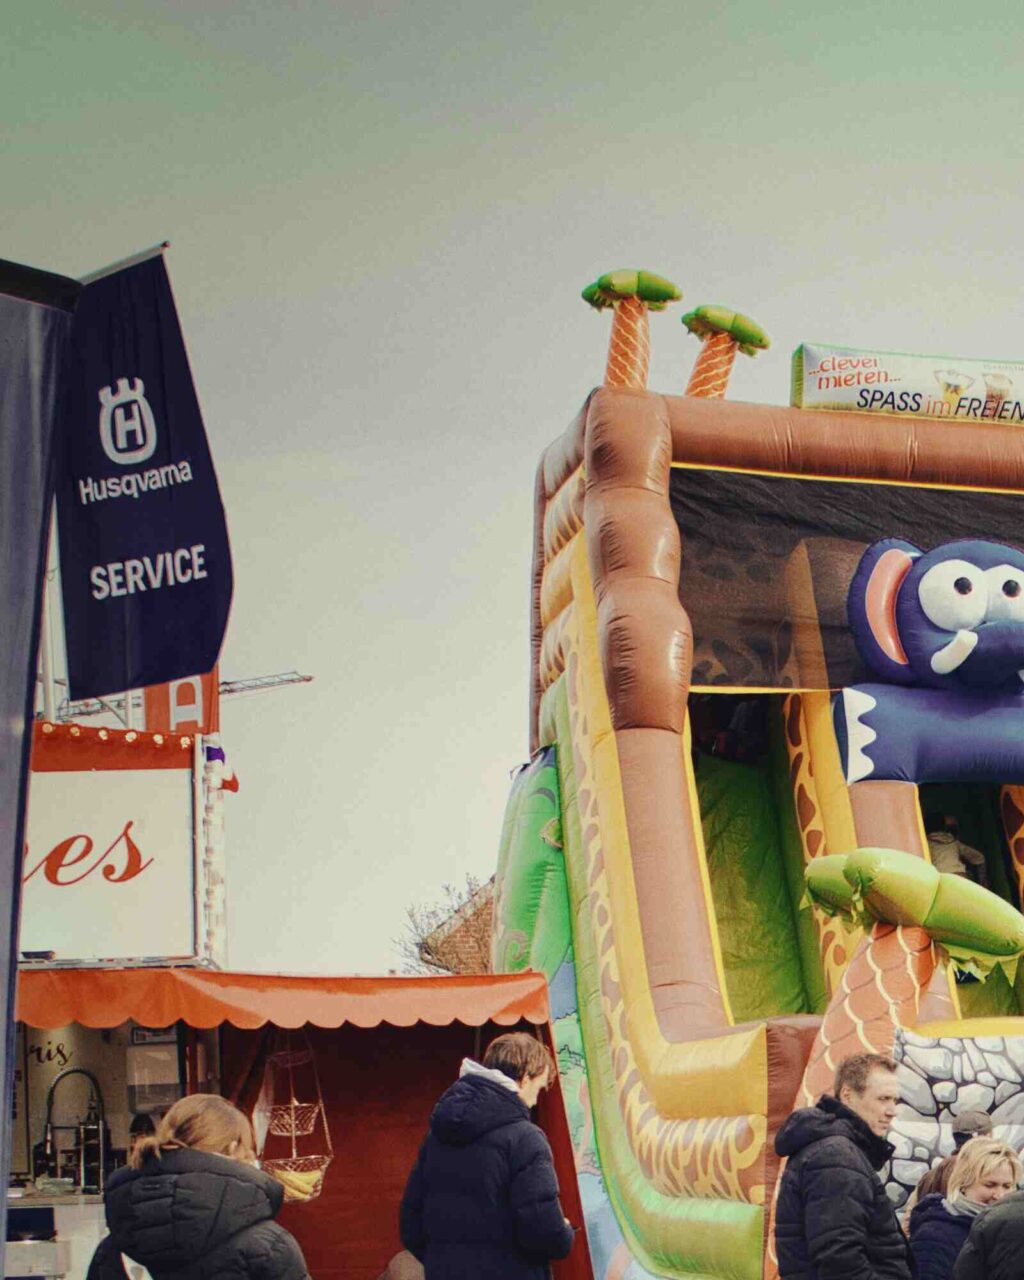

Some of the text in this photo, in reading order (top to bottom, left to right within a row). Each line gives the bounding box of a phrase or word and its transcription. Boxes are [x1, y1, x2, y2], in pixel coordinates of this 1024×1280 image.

[857, 388, 923, 413] SPASS
[925, 395, 953, 417] im
[79, 459, 194, 505] Husqvarna
[90, 544, 208, 600] SERVICE
[22, 820, 154, 886] es
